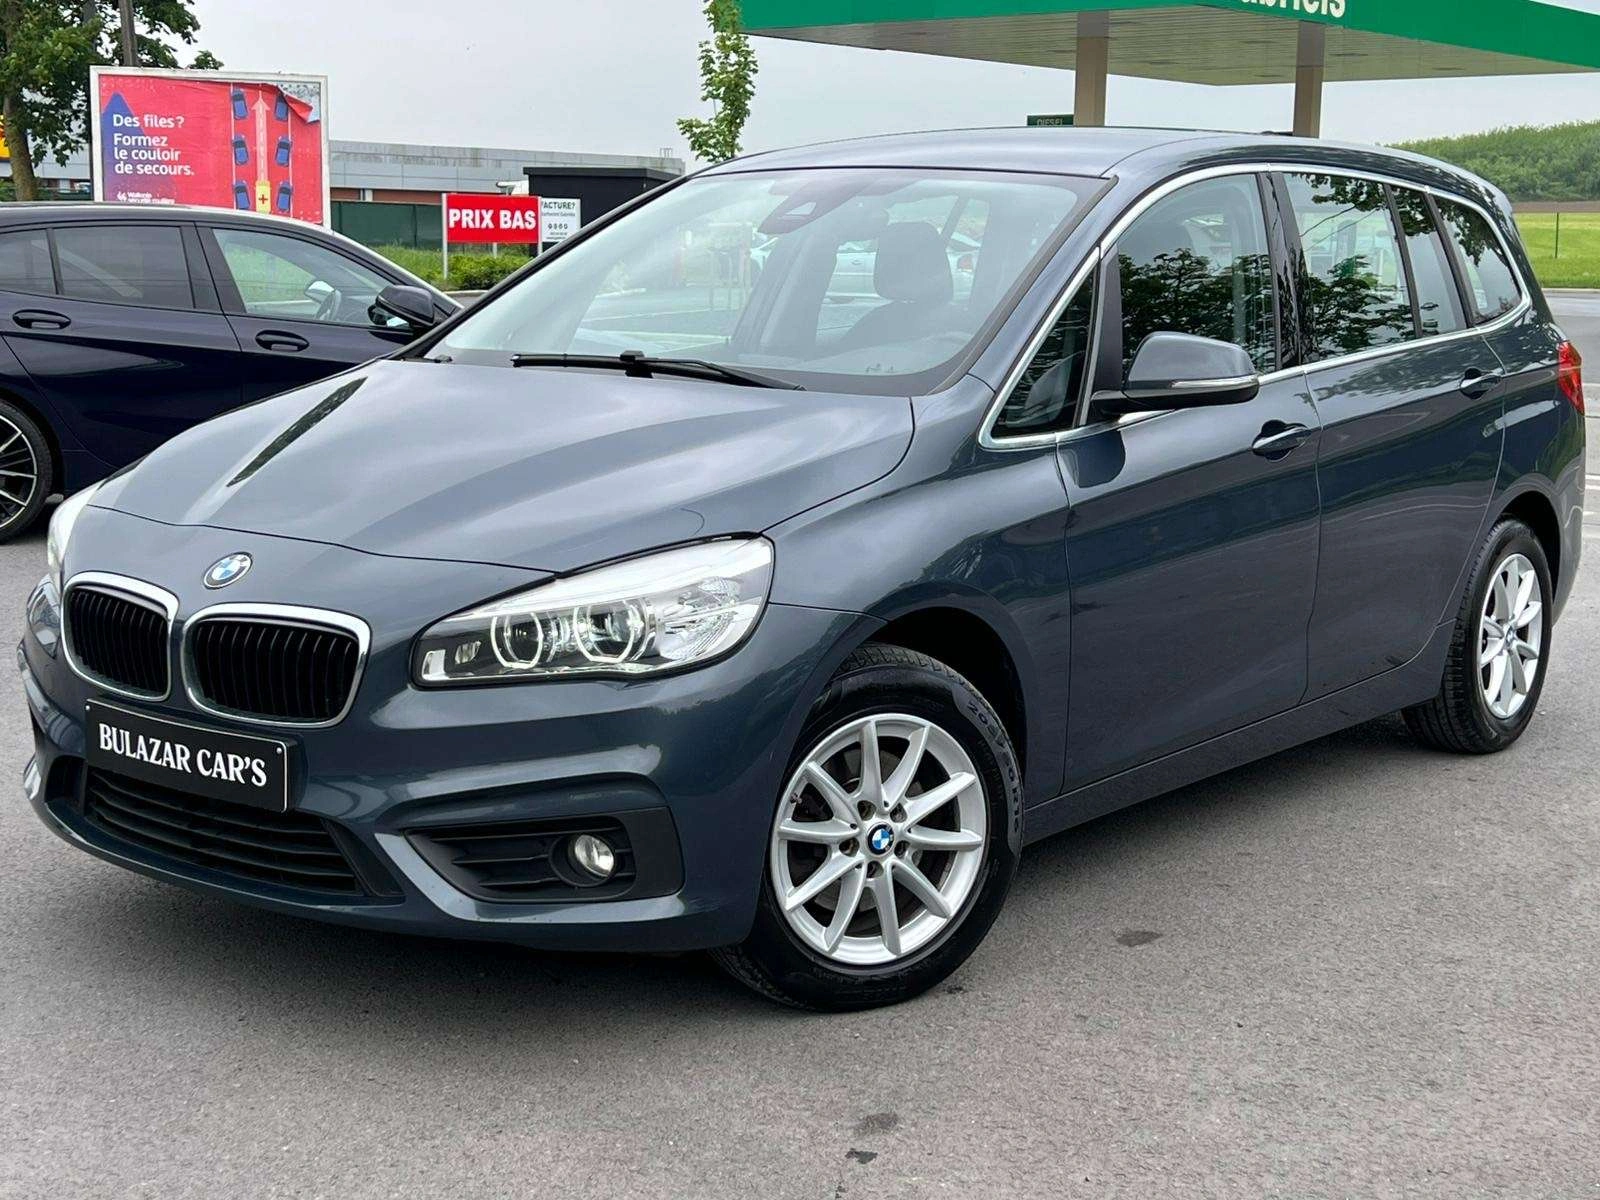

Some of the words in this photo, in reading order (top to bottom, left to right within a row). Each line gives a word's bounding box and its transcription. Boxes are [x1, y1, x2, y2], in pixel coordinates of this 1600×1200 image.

[112, 114, 140, 127] Des
[143, 114, 185, 129] files?
[113, 132, 168, 147] Formez
[114, 147, 128, 160] le
[131, 147, 181, 161] couloir
[115, 161, 134, 175] de
[137, 164, 195, 176] secours.
[449, 208, 494, 229] PRIX
[499, 209, 537, 230] BAS
[98, 722, 192, 774] BULAZAR
[196, 748, 267, 787] CAR'S
